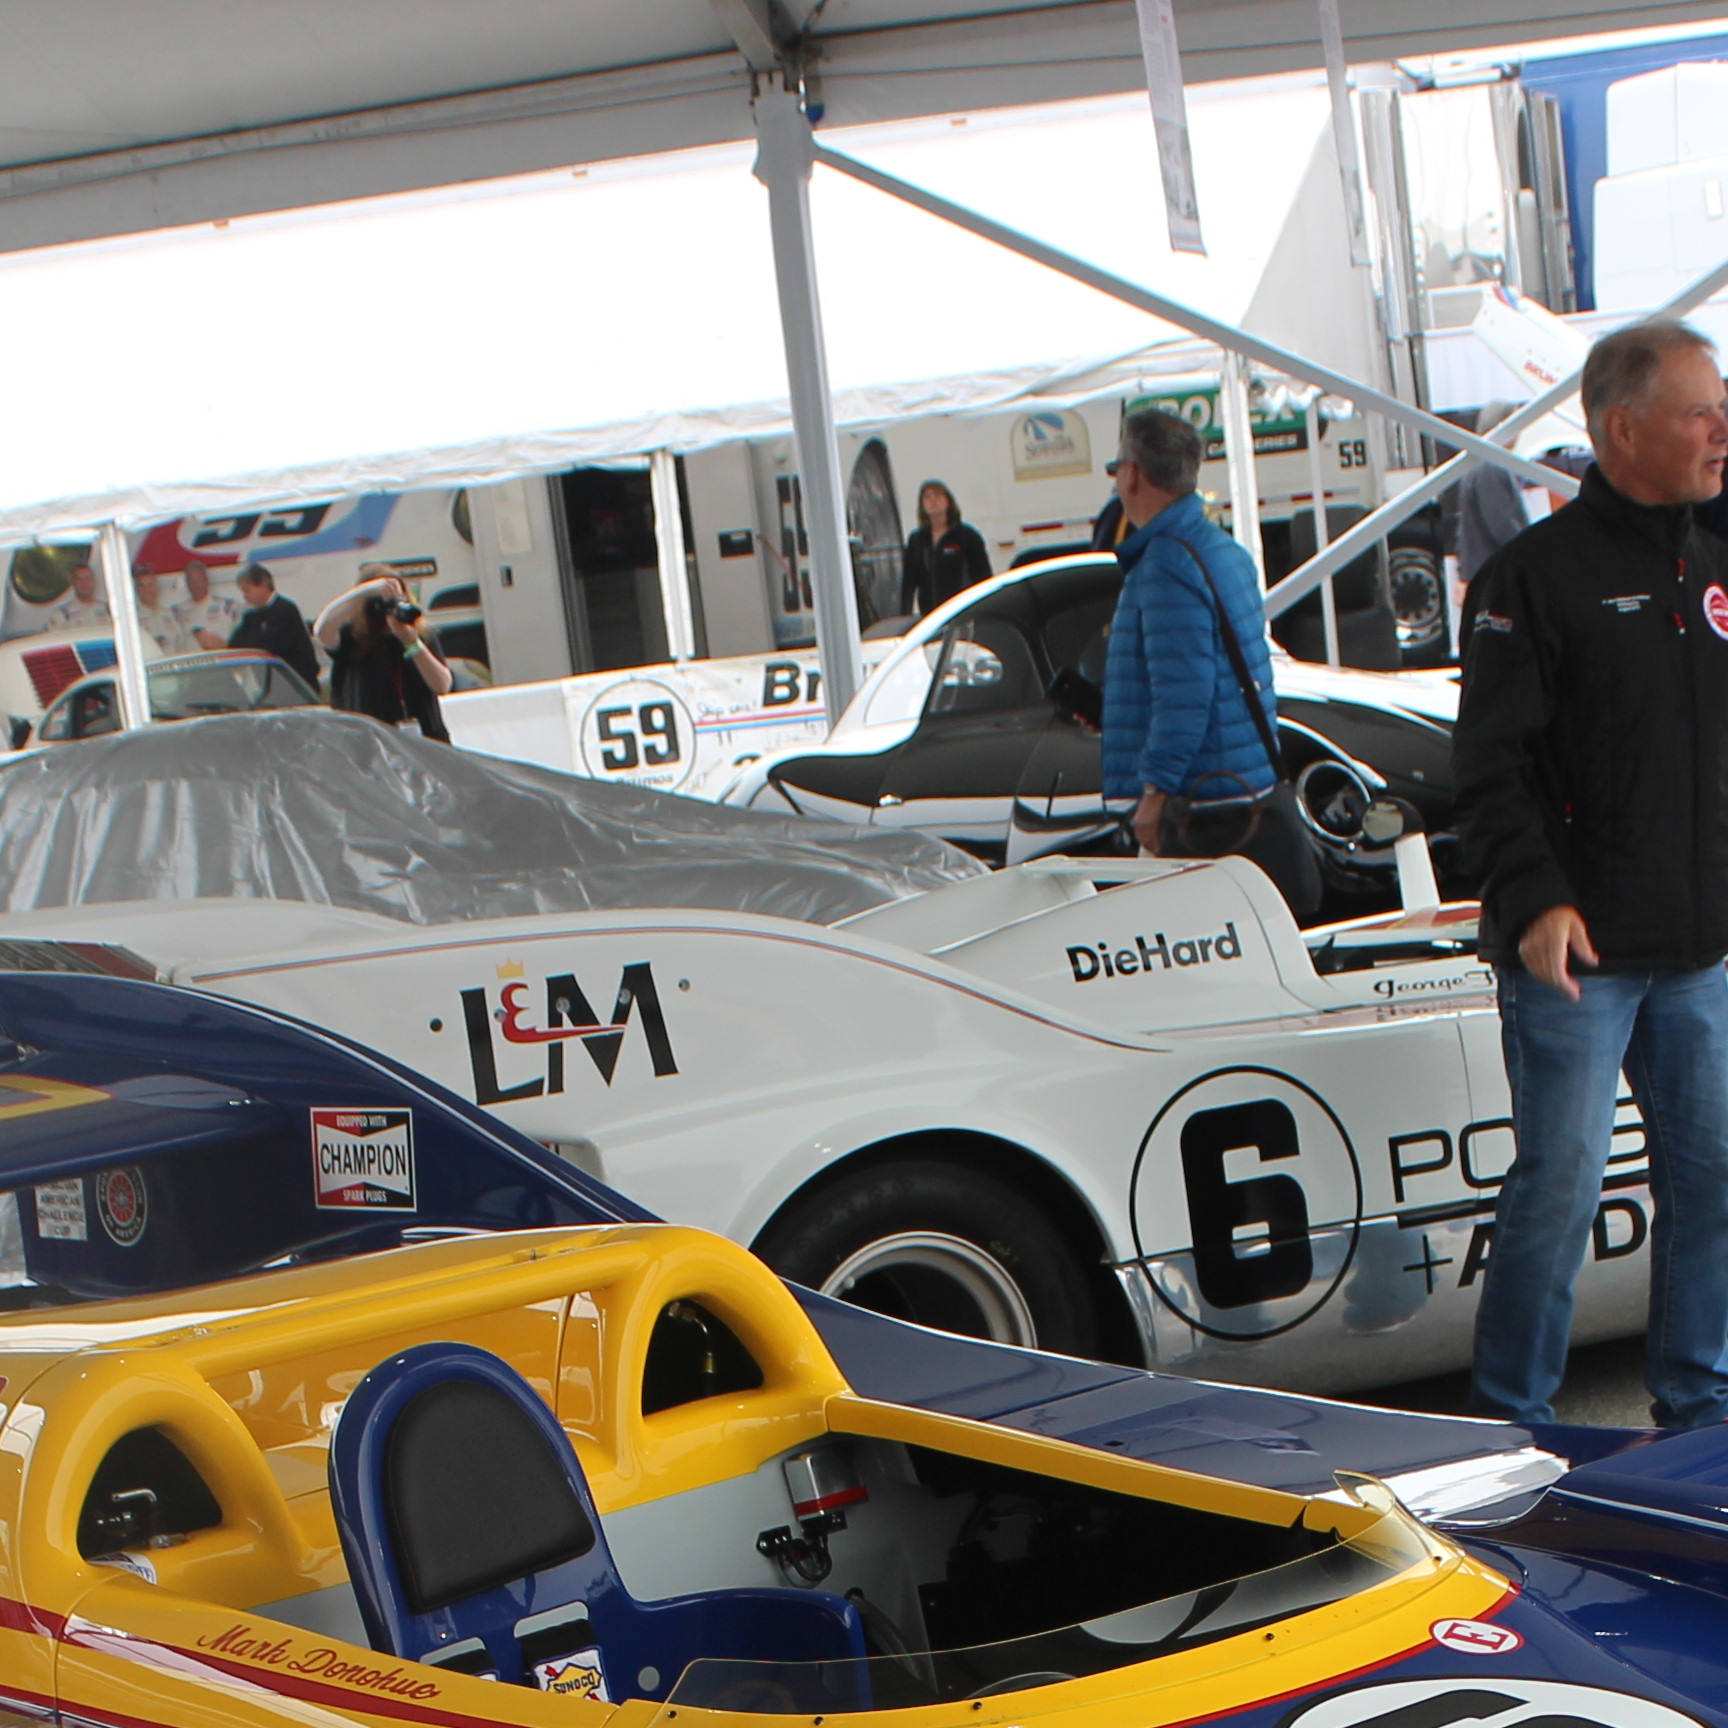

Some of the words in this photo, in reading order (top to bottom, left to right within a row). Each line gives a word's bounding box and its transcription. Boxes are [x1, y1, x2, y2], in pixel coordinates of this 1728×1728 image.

[1339, 438, 1367, 470] 59
[596, 700, 681, 772] 59
[1066, 921, 1243, 983] DieHard
[336, 1114, 369, 1127] EQUIPPED
[369, 1115, 387, 1127] WITH
[320, 1142, 407, 1176] CHAMPION
[343, 1189, 365, 1203] SPARK
[366, 1189, 387, 1203] PLUGS
[1180, 1098, 1314, 1310] 6
[1441, 1622, 1510, 1651] E
[197, 1624, 289, 1665] Mark
[288, 1648, 442, 1700] Donohue
[552, 1671, 598, 1696] SUNOCO
